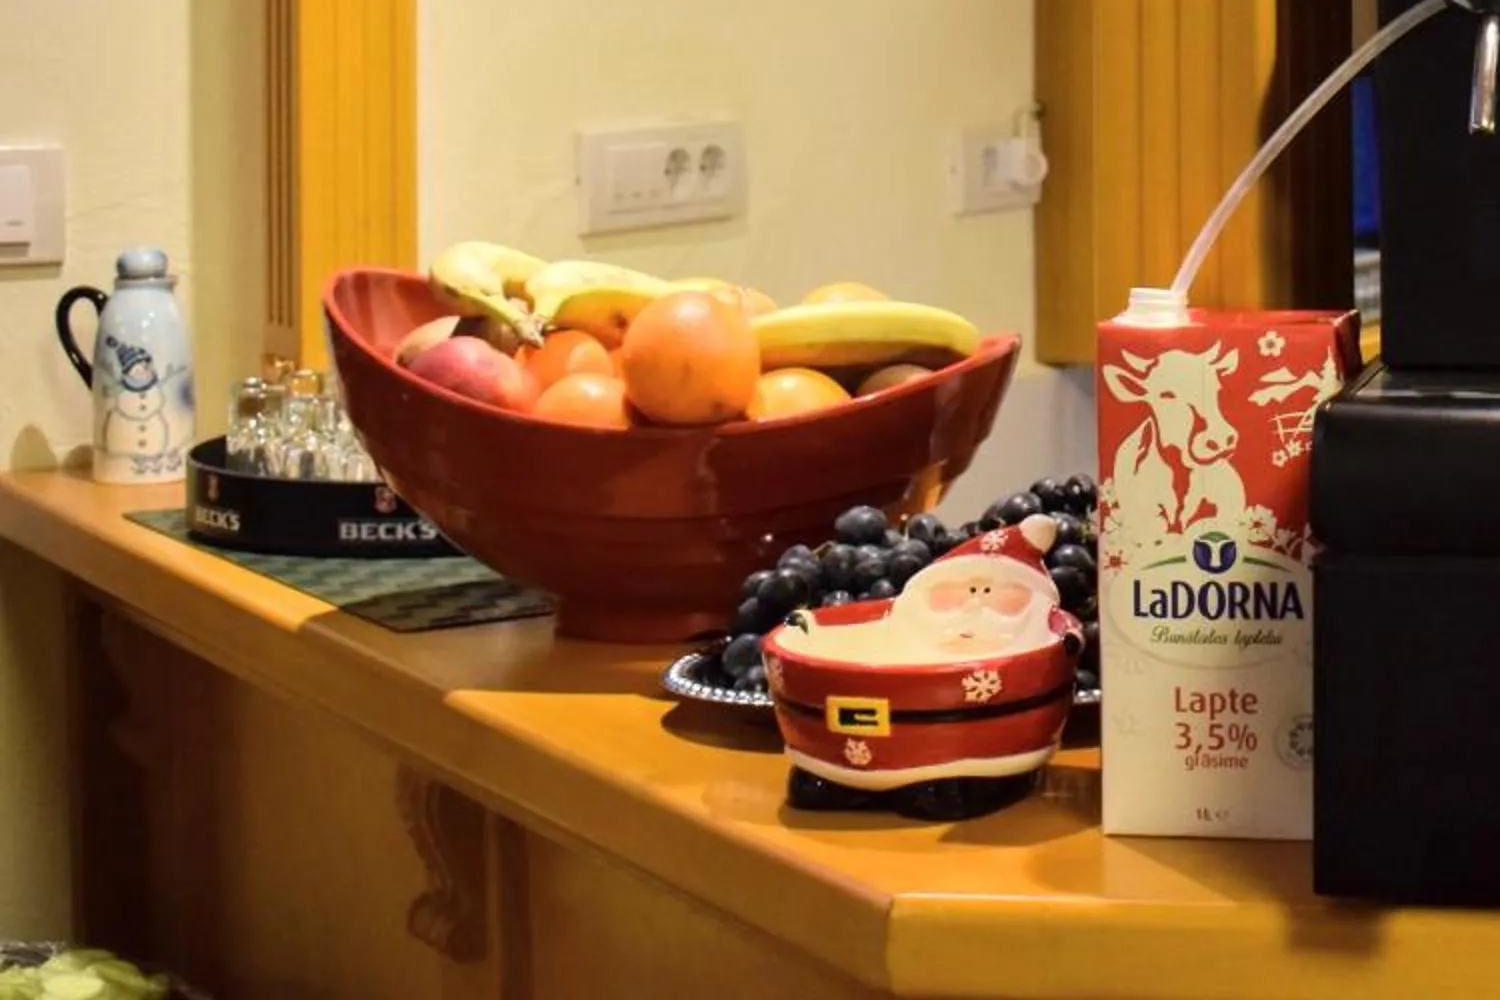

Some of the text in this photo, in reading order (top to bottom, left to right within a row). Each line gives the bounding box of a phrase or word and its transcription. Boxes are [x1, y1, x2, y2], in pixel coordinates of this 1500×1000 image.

[338, 518, 438, 541] BECK'S
[1133, 580, 1304, 621] LaDORNA
[1174, 686, 1258, 720] Lapte
[1174, 722, 1258, 755] 3,5%
